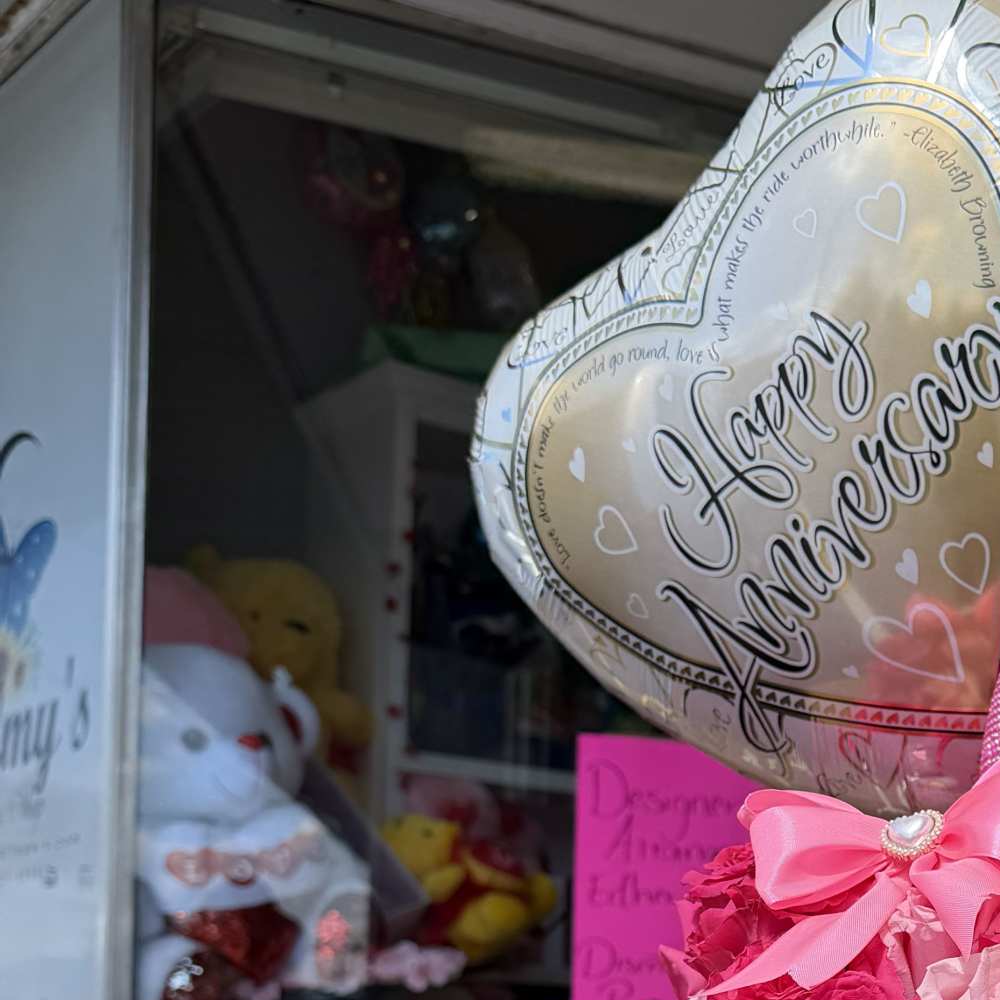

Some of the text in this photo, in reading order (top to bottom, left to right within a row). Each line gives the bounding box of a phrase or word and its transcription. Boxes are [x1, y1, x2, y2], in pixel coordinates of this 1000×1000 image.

[764, 170, 790, 204] ride
[742, 206, 765, 233] the
[960, 197, 996, 289] Browning
[725, 235, 749, 291] makes
[711, 296, 736, 342] what
[609, 352, 624, 376] go
[677, 337, 703, 365] love
[707, 341, 720, 362] is
[571, 360, 606, 393] world
[652, 310, 867, 575] Happy
[533, 463, 551, 523] doesn't
